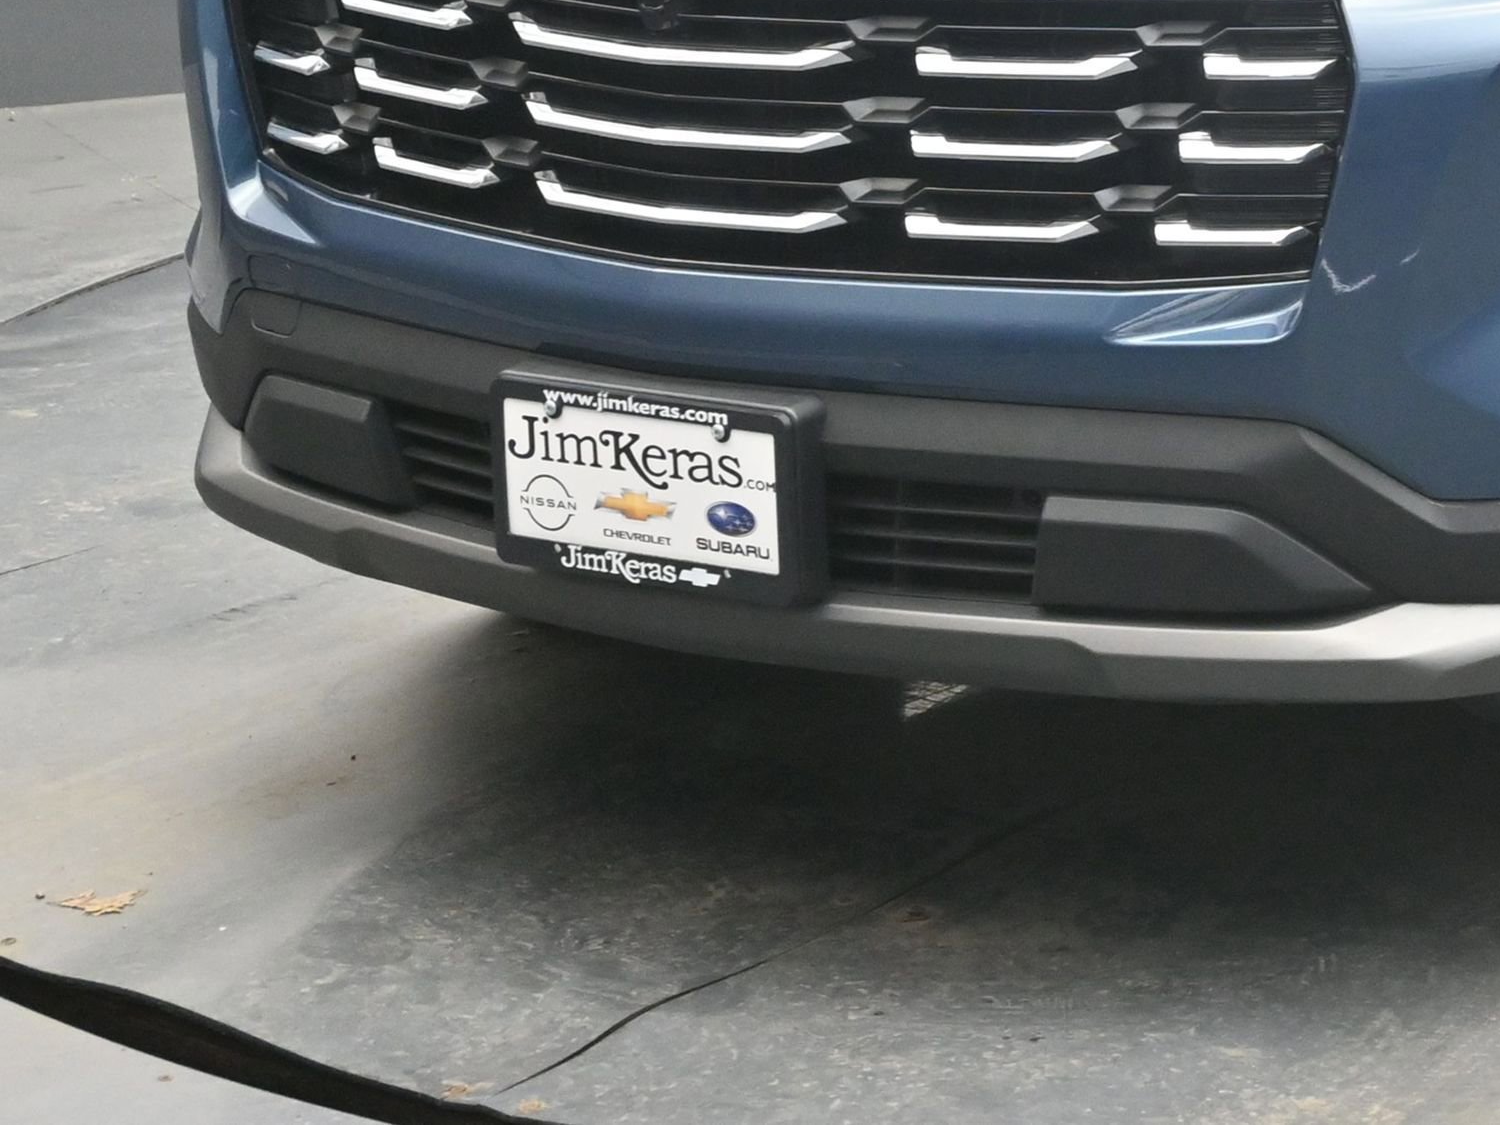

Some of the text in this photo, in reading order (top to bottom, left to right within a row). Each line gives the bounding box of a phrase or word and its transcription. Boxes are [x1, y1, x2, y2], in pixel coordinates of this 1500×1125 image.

[543, 389, 729, 425] www.jimkeras.com
[520, 495, 577, 511] NISSAN
[603, 527, 672, 546] CHEVROLET
[695, 537, 770, 560] SUBARU
